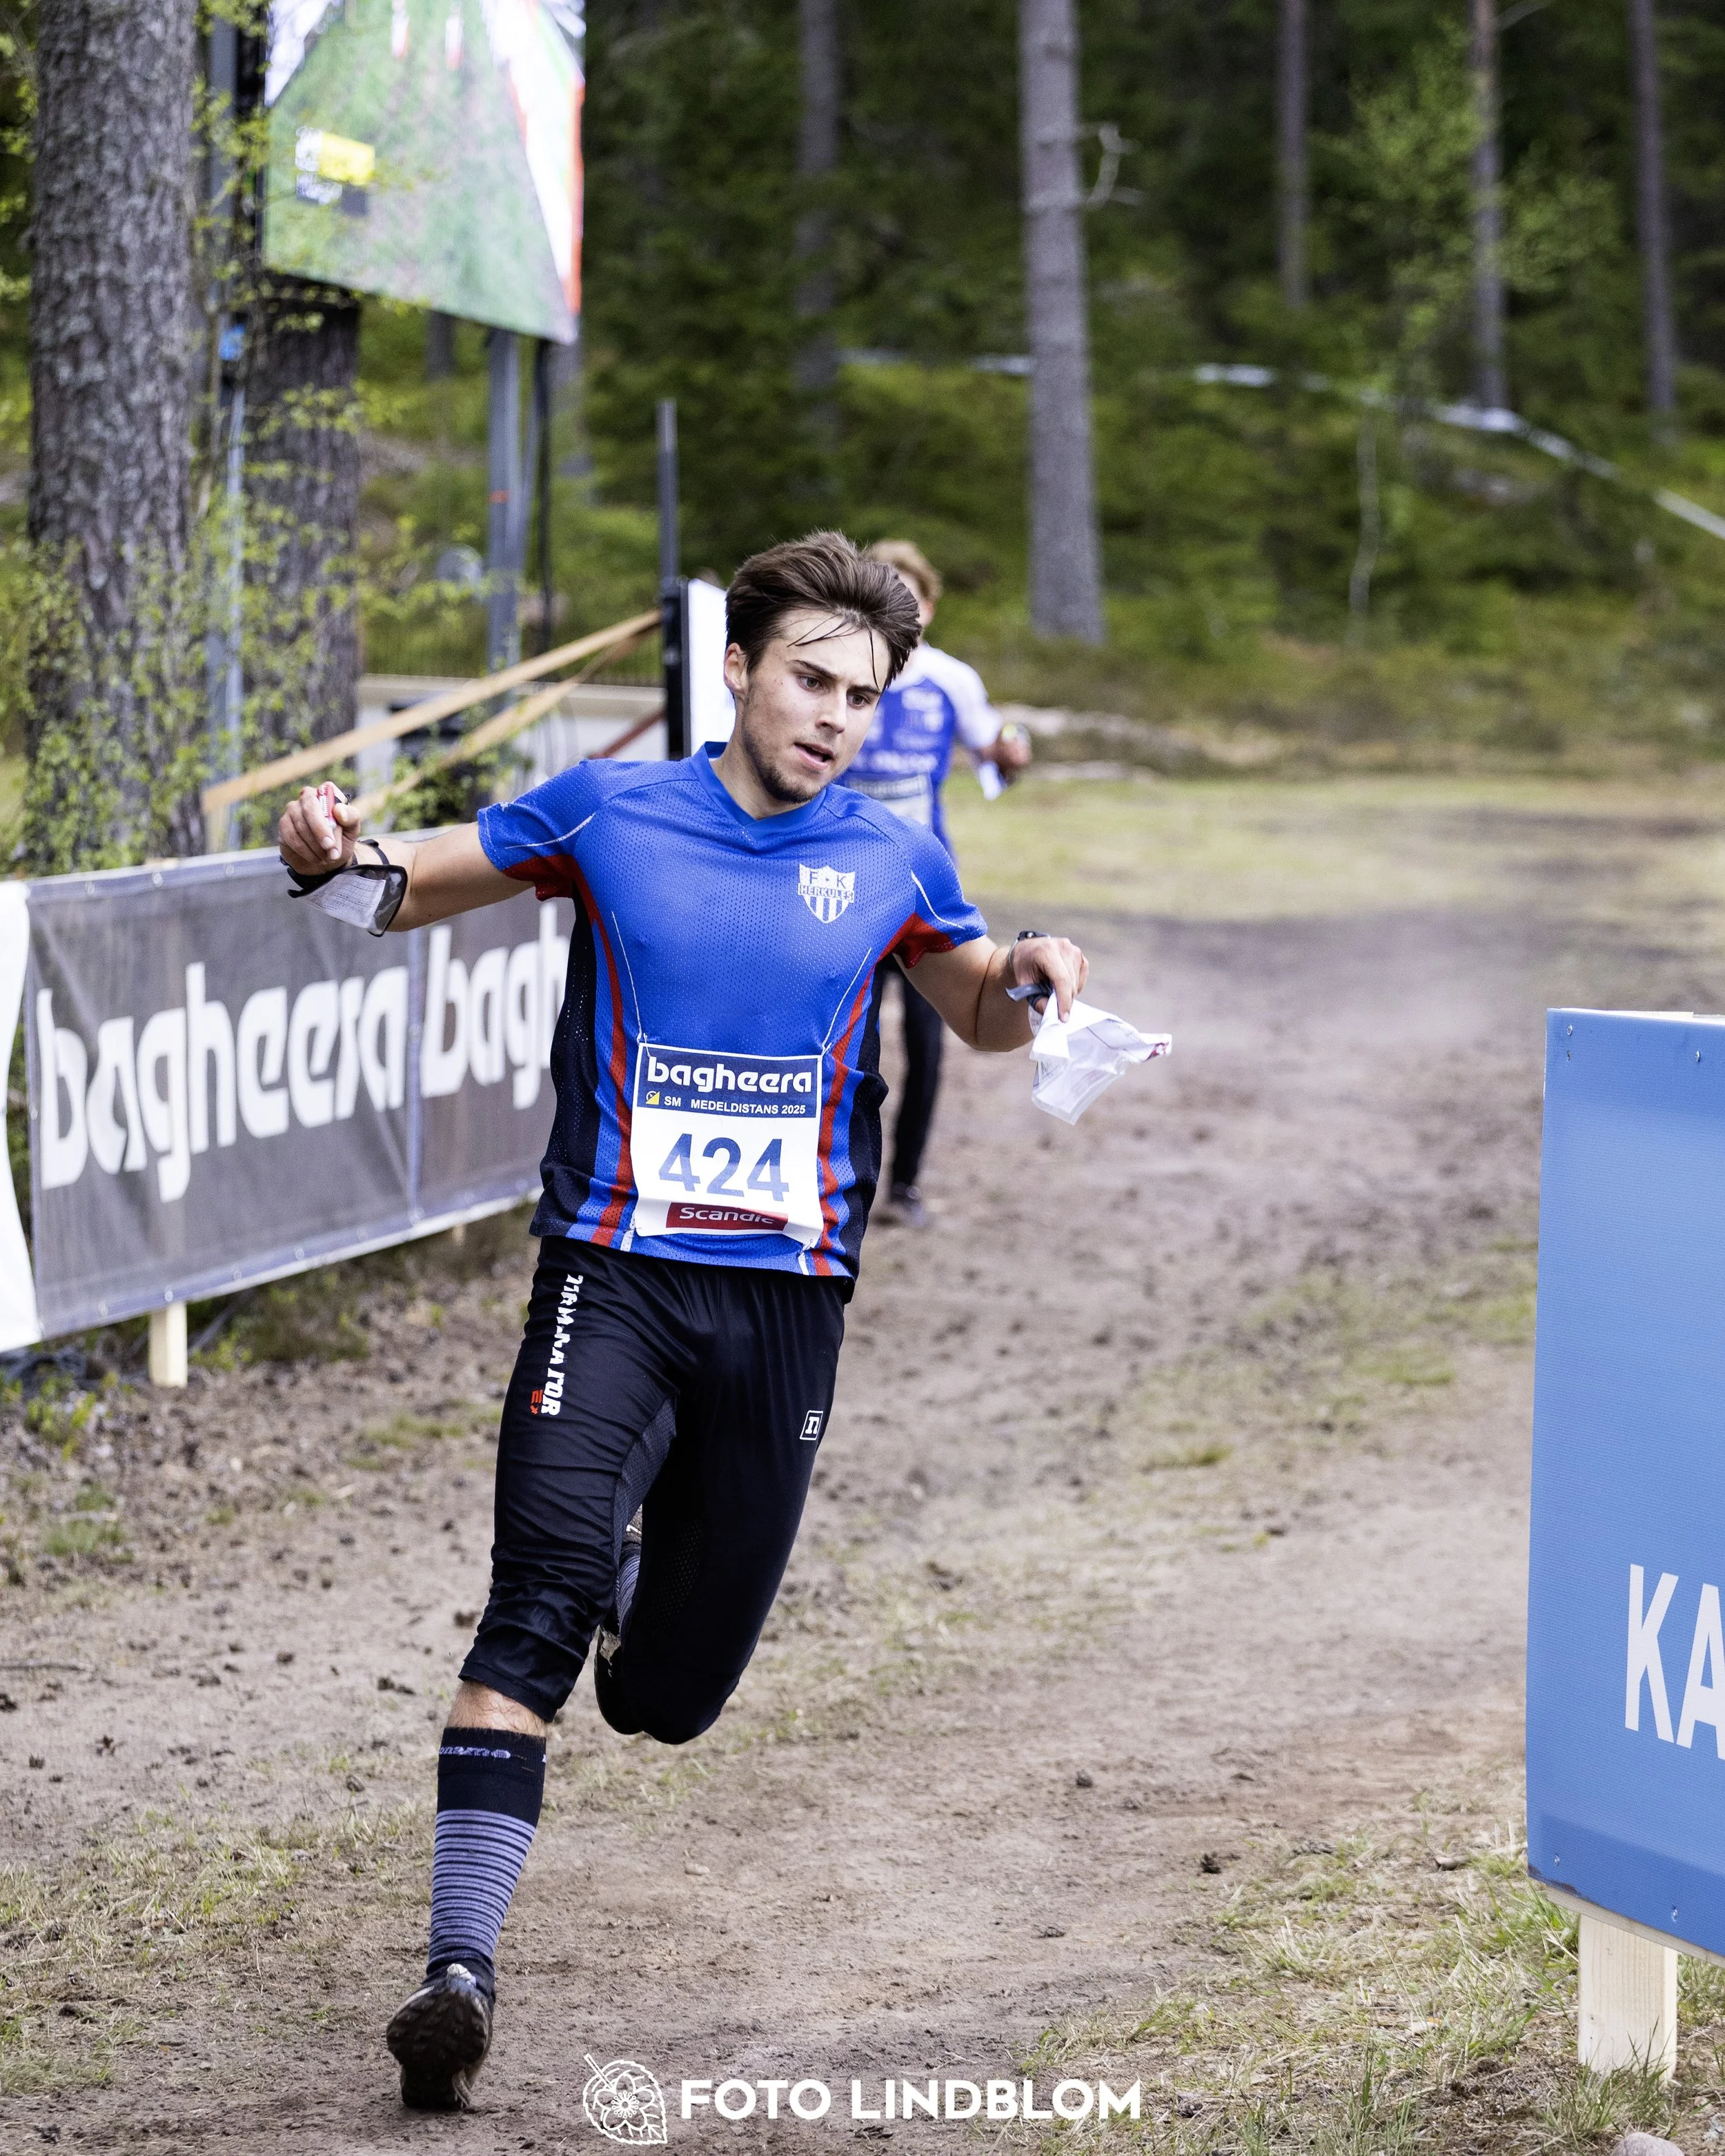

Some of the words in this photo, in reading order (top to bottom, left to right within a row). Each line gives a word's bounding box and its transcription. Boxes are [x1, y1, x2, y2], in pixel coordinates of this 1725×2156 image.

[36, 962, 409, 1203] bagheera
[647, 1056, 812, 1094] bagheera
[664, 1096, 682, 1107] SM
[690, 1098, 779, 1115] MEDELDISTANS
[781, 1104, 807, 1115] 2025
[658, 1132, 790, 1203] 424
[679, 1207, 775, 1225] Scandic
[541, 1274, 584, 1416] TRMNATOR
[1625, 1563, 1725, 1761] KA
